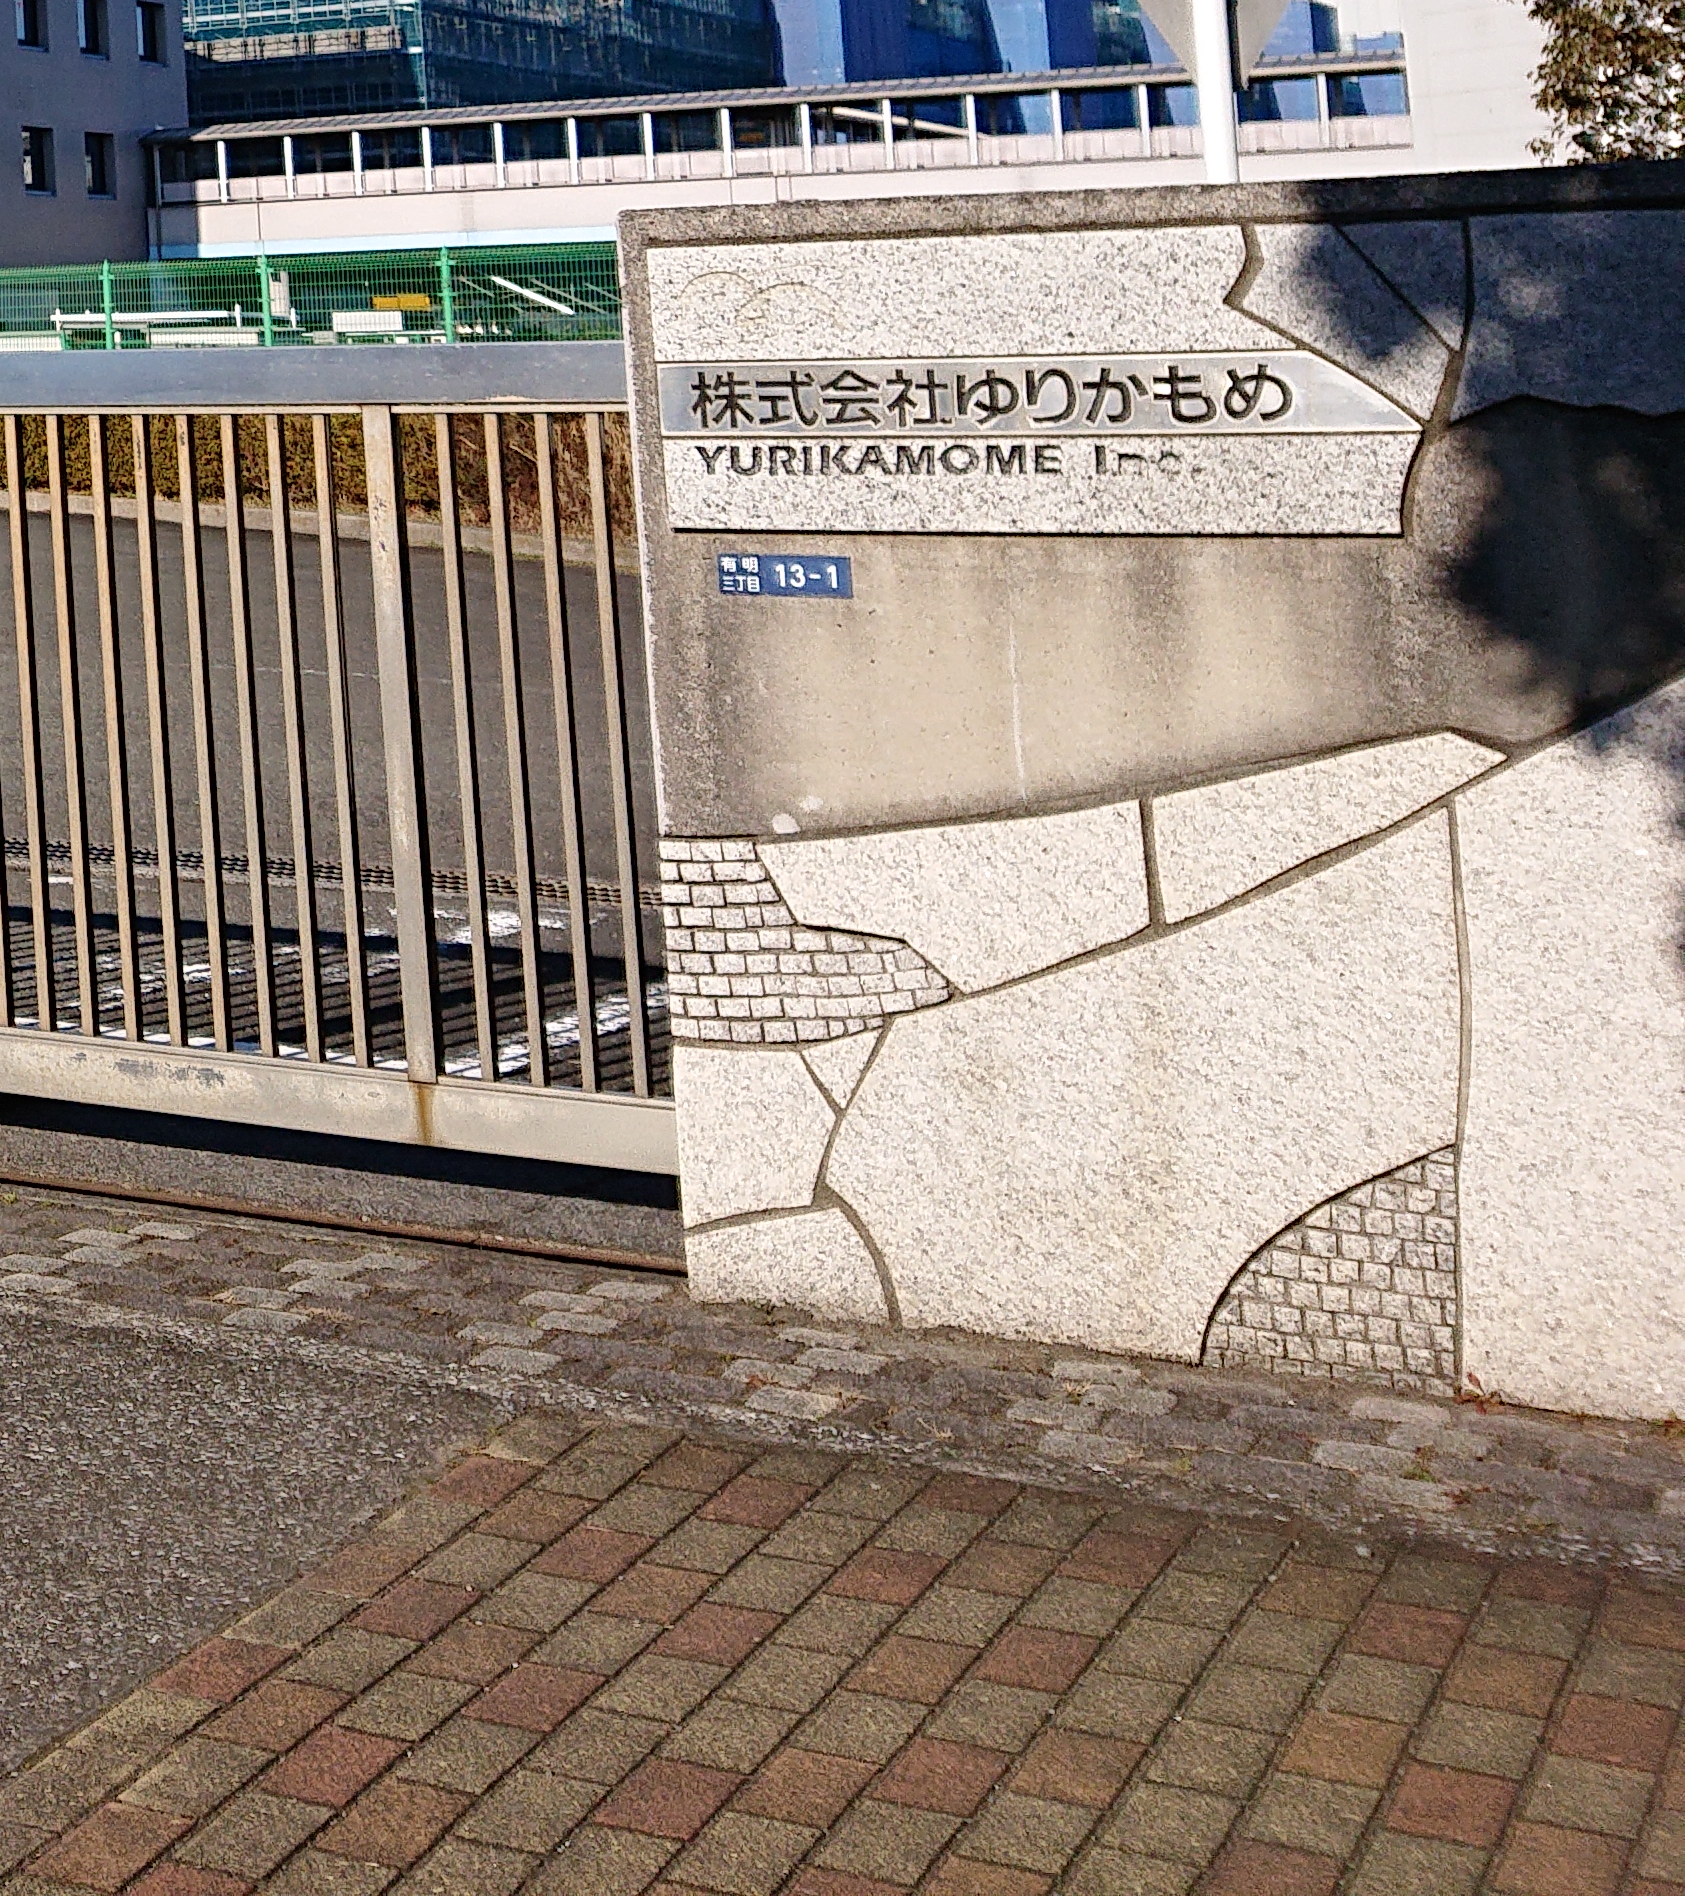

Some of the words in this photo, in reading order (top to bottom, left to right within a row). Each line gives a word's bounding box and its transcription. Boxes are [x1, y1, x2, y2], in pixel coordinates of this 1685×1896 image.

[691, 364, 1294, 429] 株式会社ゆりかもめ
[695, 444, 1063, 476] YURIKAMOME
[720, 556, 759, 573] 有明
[775, 563, 838, 589] 13-1
[721, 574, 760, 593] 三丁目
